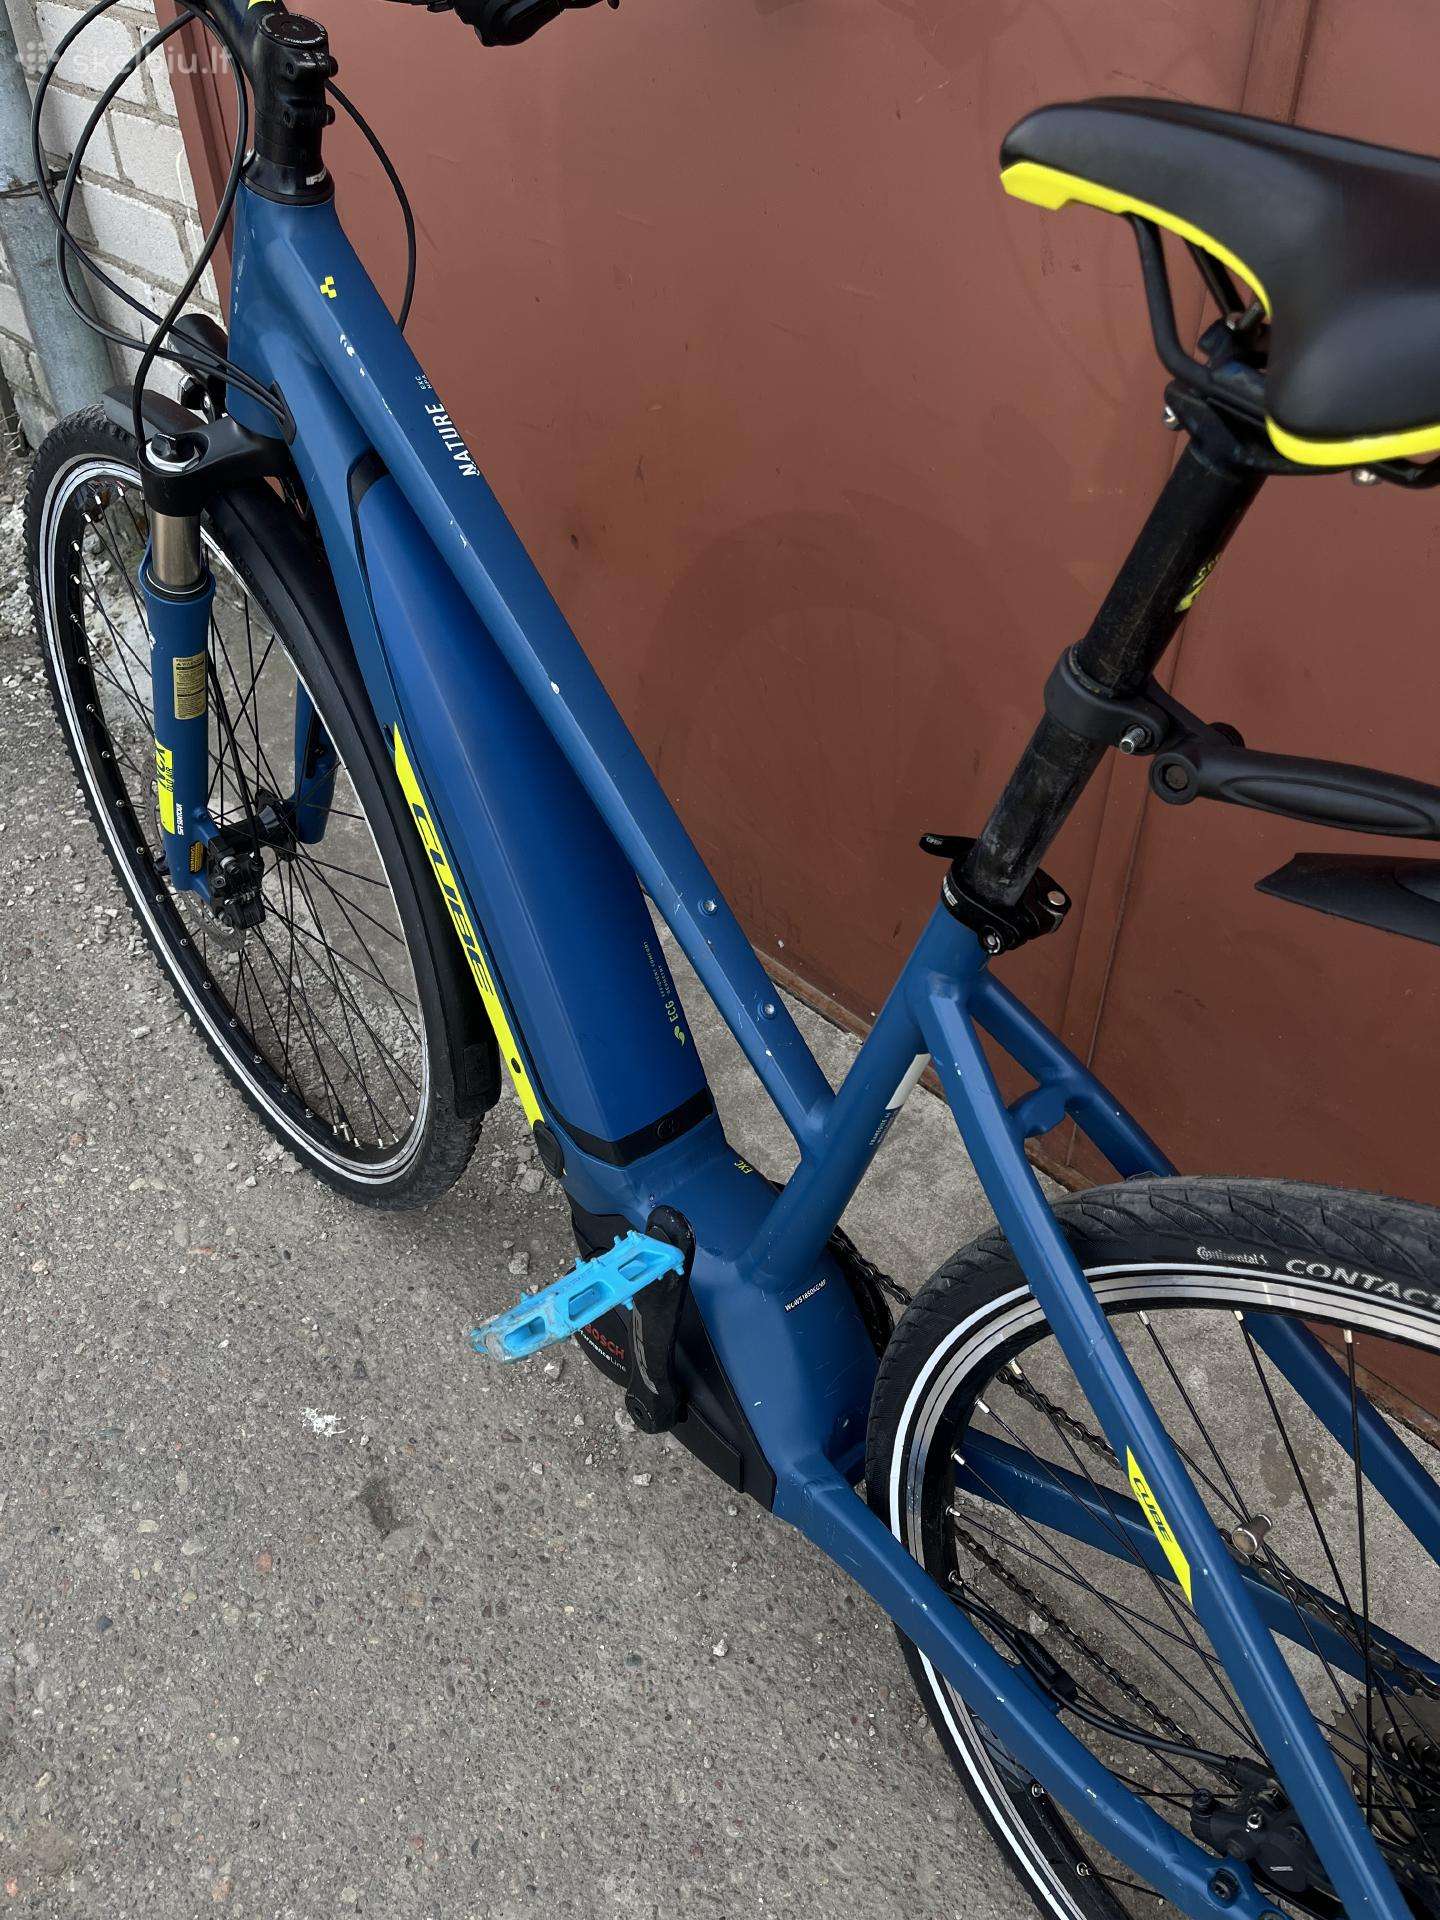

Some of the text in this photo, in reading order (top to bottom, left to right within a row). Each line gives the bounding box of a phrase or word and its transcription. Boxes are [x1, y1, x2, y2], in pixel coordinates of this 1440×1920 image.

[424, 403, 478, 477] NATURE
[411, 802, 495, 997] CUBE
[1133, 1477, 1173, 1545] CUBE
